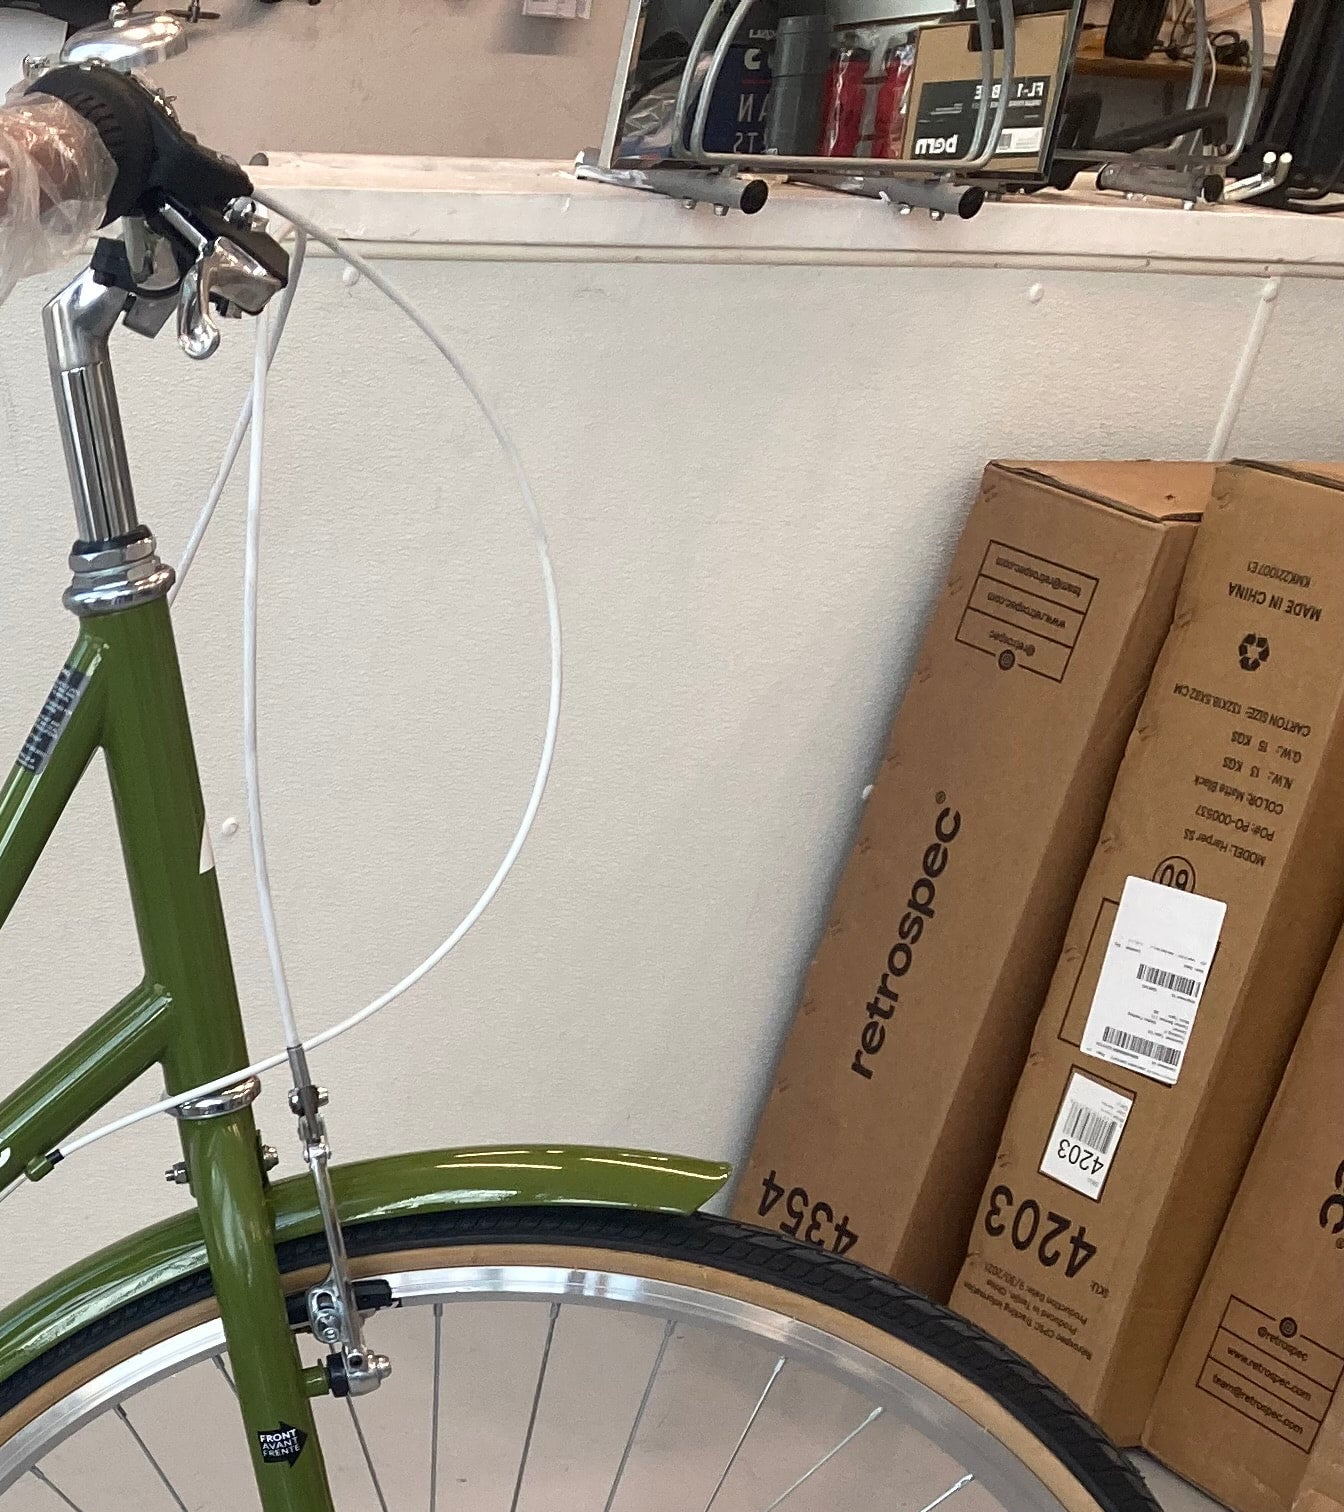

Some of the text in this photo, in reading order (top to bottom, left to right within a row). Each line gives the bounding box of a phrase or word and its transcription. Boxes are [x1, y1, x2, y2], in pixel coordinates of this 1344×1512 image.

[987, 592, 1066, 629] www.retrospec.com
[1229, 581, 1322, 621] MADE IN CHINA
[1173, 683, 1189, 697] CM
[1245, 707, 1269, 724] SIZE:
[1269, 713, 1311, 737] CARTON
[1231, 731, 1253, 746] KGS
[1222, 756, 1244, 772] KGS
[1193, 775, 1284, 815] COLOR: Matte Black
[1196, 833, 1228, 853] Harper
[1230, 844, 1266, 867] MODEL:
[1058, 1139, 1104, 1175] 4203
[758, 1170, 859, 1254] 4354
[985, 1185, 1097, 1278] 4203
[1258, 1326, 1308, 1362] @retrospec
[1227, 1346, 1312, 1401] www.retrospec.com
[1213, 1374, 1303, 1434] team@retrospec.com
[259, 1429, 296, 1443] FRONT
[262, 1436, 298, 1450] AVANT
[263, 1444, 300, 1457] FRENTE
